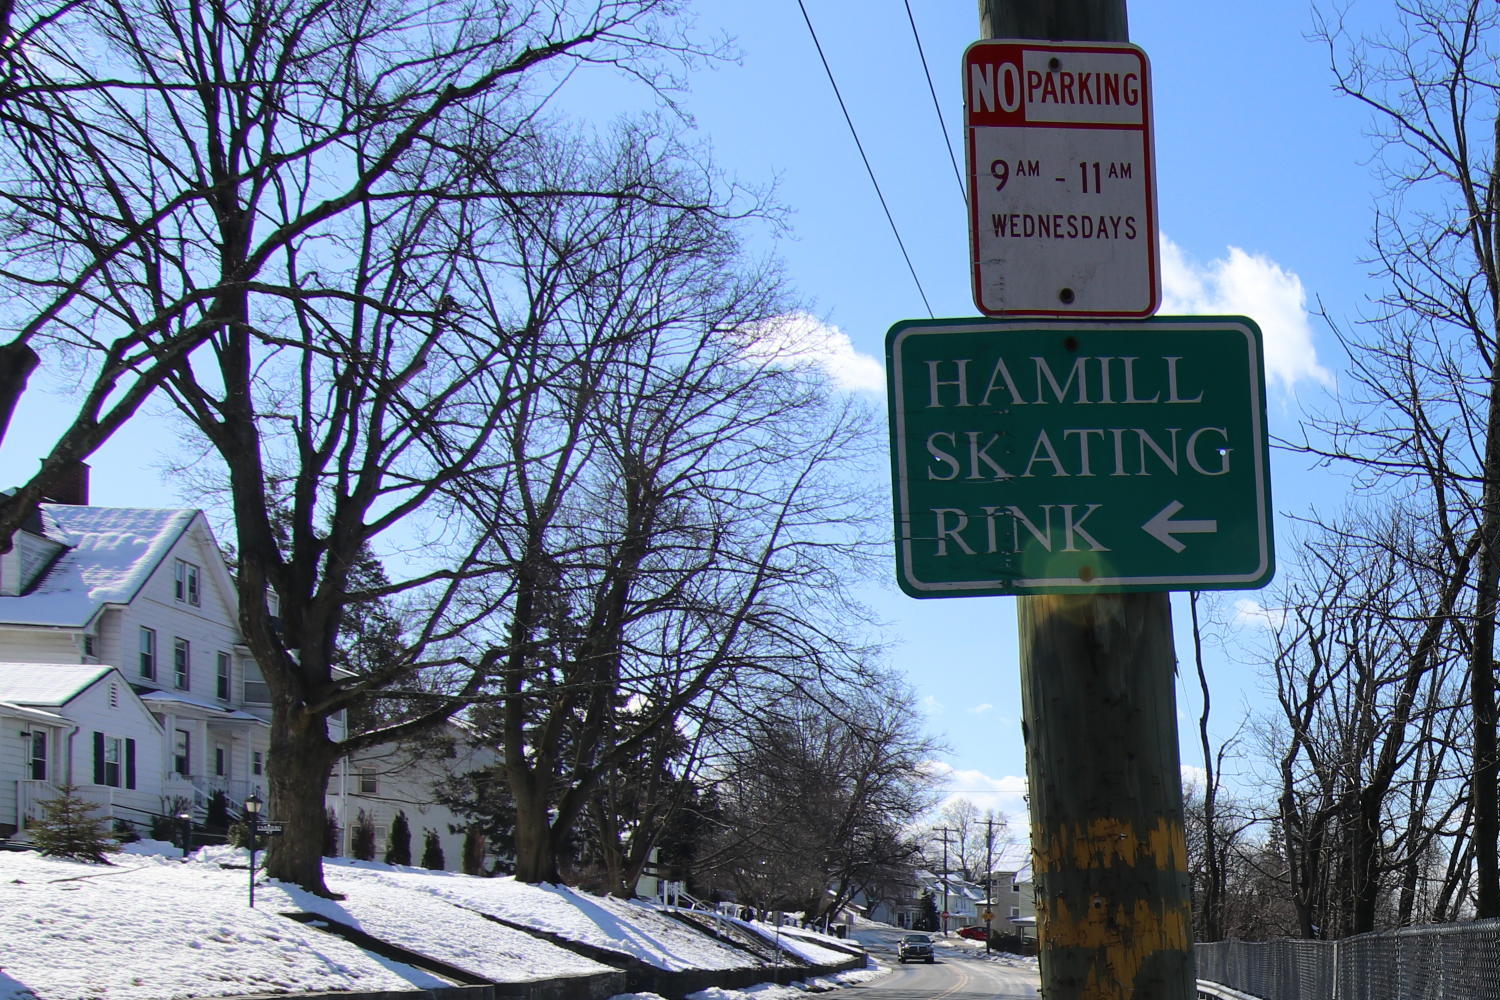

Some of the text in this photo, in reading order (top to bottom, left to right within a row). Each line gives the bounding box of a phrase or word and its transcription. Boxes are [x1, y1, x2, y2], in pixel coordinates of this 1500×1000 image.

[970, 61, 1139, 114] NO PARKING
[992, 213, 1137, 240] WEDNESDAYS
[923, 356, 1204, 409] HAMILL
[926, 426, 1235, 481] SKATING
[929, 503, 1112, 557] RINK
